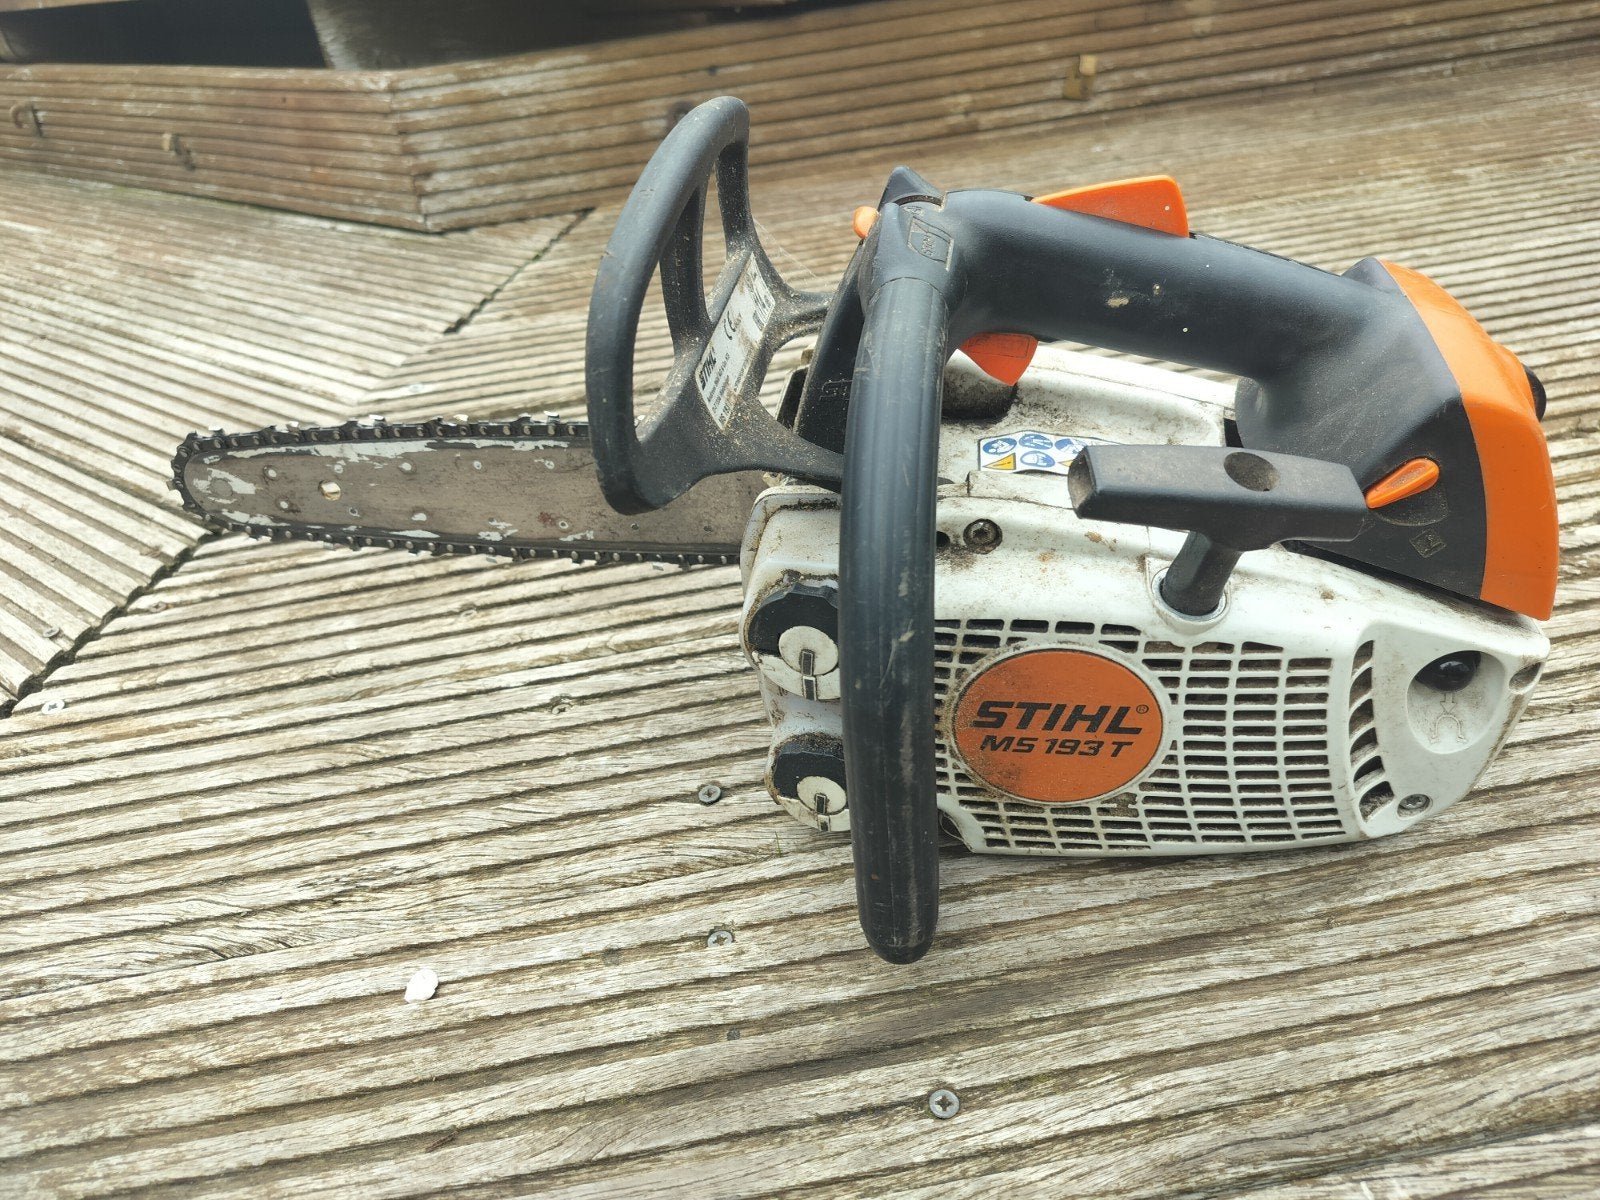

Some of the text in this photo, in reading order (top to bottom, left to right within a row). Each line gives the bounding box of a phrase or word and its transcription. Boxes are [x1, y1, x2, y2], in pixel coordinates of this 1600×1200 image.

[980, 735, 1133, 757] MS 193 T
